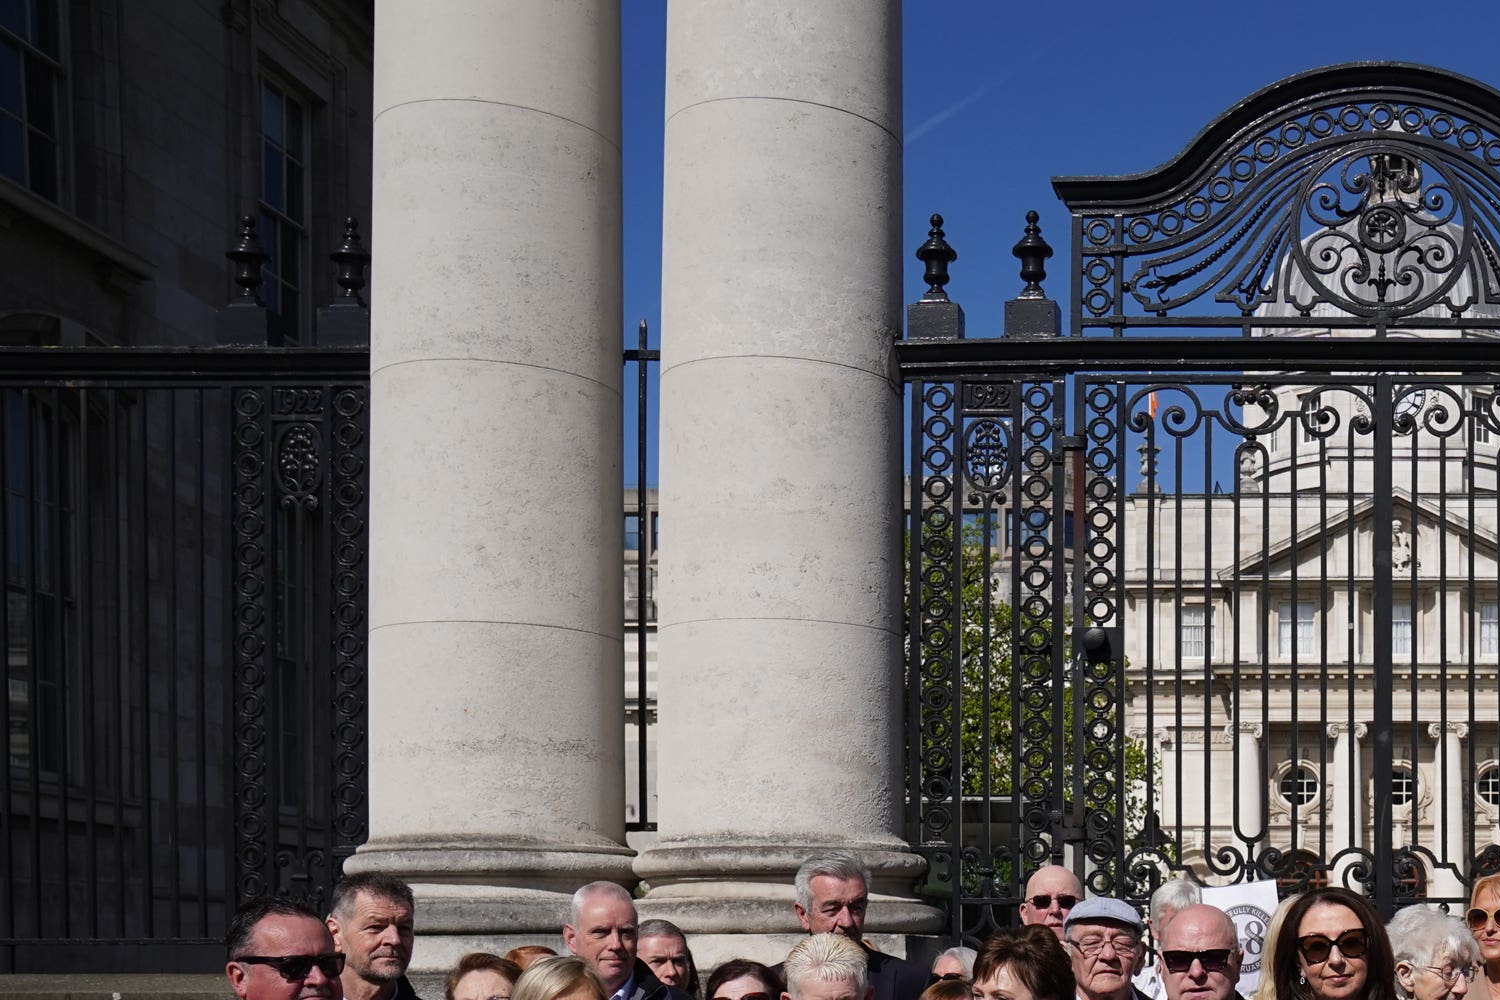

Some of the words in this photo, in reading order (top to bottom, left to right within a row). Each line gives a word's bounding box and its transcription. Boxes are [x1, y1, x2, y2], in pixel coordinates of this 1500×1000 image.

[965, 384, 1010, 409] 1922
[1251, 909, 1270, 924] KILLE
[1234, 921, 1265, 955] 8
